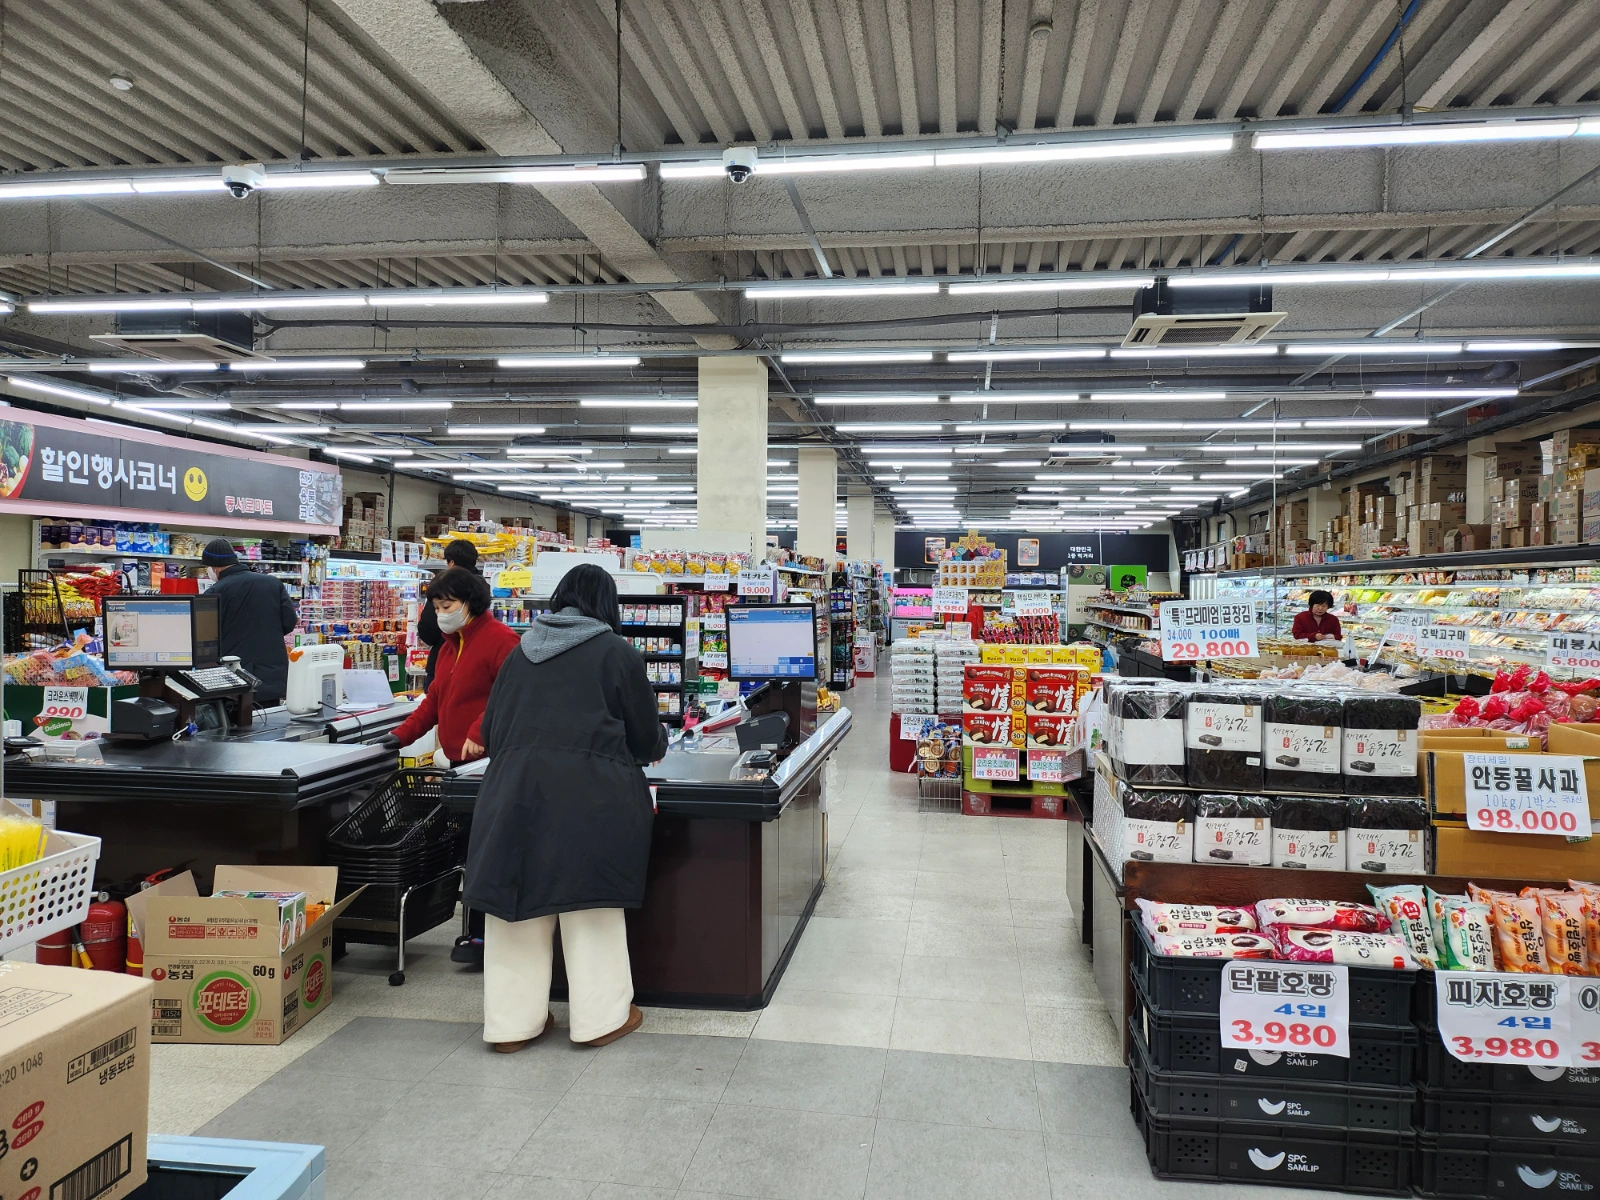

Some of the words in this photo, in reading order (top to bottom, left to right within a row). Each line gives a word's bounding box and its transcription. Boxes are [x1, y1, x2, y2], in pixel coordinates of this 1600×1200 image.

[41, 446, 177, 495] 할인행사코너
[299, 487, 316, 504] 용품
[225, 495, 274, 515] 동서로마트
[299, 504, 316, 520] 코너
[1222, 604, 1251, 624] 곱창김
[1167, 628, 1192, 641] 34,000
[1200, 628, 1240, 640] 100매
[1421, 628, 1466, 641] 호박고구마
[1171, 641, 1251, 659] 29,800
[991, 682, 1011, 712] 情
[1055, 684, 1075, 714] 情
[45, 706, 83, 719] 990
[44, 720, 71, 732] Delicious
[991, 715, 1011, 745] 情
[1471, 766, 1580, 795] 안동꿀사과
[1485, 794, 1557, 811] 10kg/1박스
[1477, 809, 1577, 832] 98,000
[1170, 909, 1213, 921] 삼립호빵
[1404, 904, 1418, 913] 1+1
[1181, 936, 1227, 950] 삼립호빵
[1410, 917, 1429, 955] 립호빵
[1468, 922, 1487, 966] 삼립호빵
[1519, 919, 1541, 964] 삼립호빵
[1566, 918, 1582, 964] 삼립호빵
[253, 965, 266, 976] 60
[268, 967, 275, 978] g
[291, 957, 304, 974] 농심
[168, 969, 194, 980] 농심
[1230, 968, 1335, 997] 단팥호빵
[196, 988, 251, 1014] 포테토칩
[1448, 979, 1556, 1009] 피자호빵
[1273, 1003, 1327, 1018] 4입
[1496, 1016, 1552, 1030] 4입
[1231, 1020, 1337, 1047] 3,980
[1451, 1036, 1560, 1060] 3,980
[21, 1052, 43, 1076] 1048
[99, 1053, 136, 1086] 냉동보관
[1286, 1058, 1319, 1067] SAMLIP
[1569, 1066, 1588, 1075] SPC
[1569, 1075, 1600, 1084] SAMLIP
[1287, 1102, 1302, 1110] SPC
[1287, 1109, 1311, 1117] SAMLIP
[17, 1108, 33, 1127] 300
[34, 1103, 41, 1115] g
[1562, 1120, 1577, 1128] SPC
[1562, 1126, 1588, 1135] SAMLIP
[16, 1129, 33, 1147] 300
[33, 1124, 40, 1136] g
[1287, 1154, 1307, 1164] SPC
[1287, 1163, 1320, 1173] SAMLIP
[1560, 1173, 1580, 1182] SPC
[1559, 1181, 1594, 1192] SAMLIP
